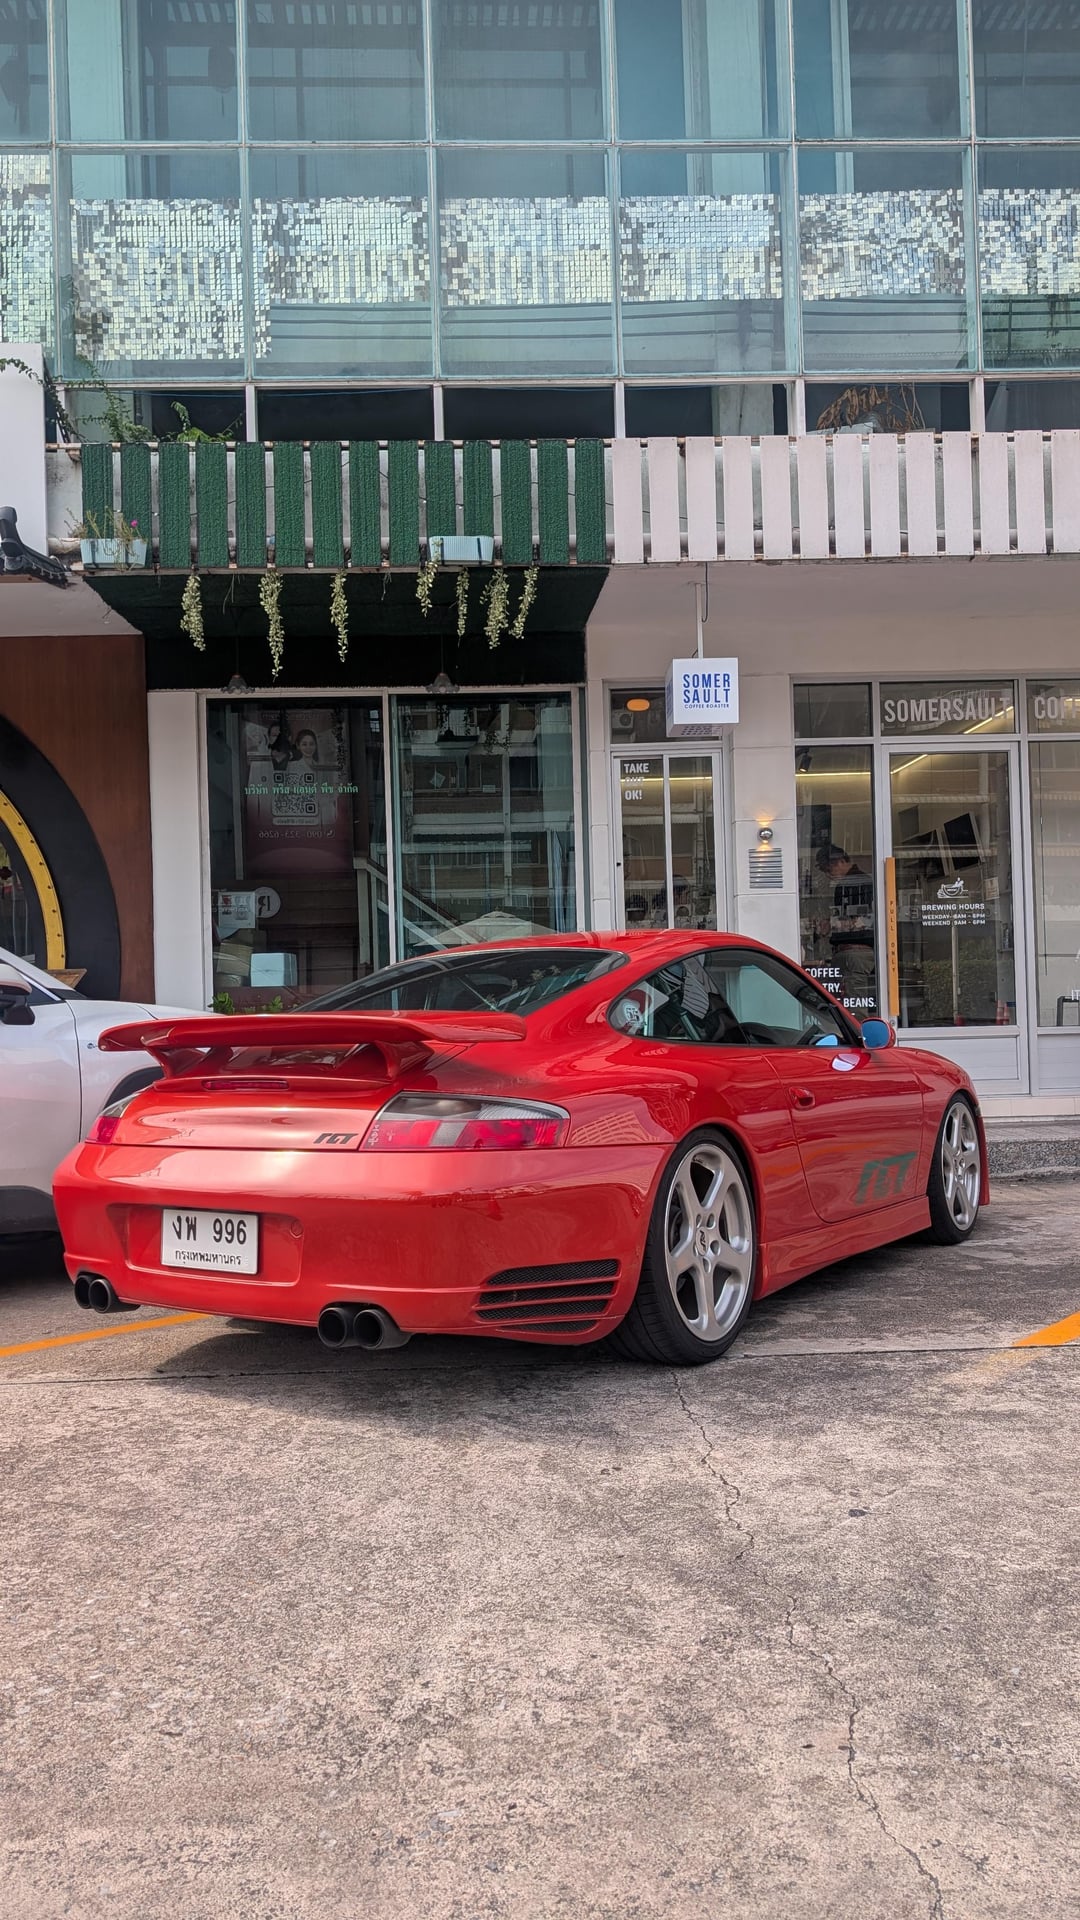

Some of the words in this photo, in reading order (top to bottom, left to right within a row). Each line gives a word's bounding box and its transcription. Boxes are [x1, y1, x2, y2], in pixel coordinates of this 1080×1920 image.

[683, 673, 731, 689] SOMER
[683, 688, 731, 704] SAULT
[884, 696, 1012, 722] SOMERSAULT
[623, 763, 650, 774] TAKE
[244, 783, 268, 795] บริษัท
[337, 782, 359, 794] จำกัด
[625, 790, 643, 800] OK!
[921, 903, 957, 911] BREWING
[843, 997, 877, 1008] BEANS.
[172, 1215, 197, 1241] งพ
[212, 1217, 247, 1245] 996
[175, 1250, 242, 1265] กรุงเทพมหานคร
